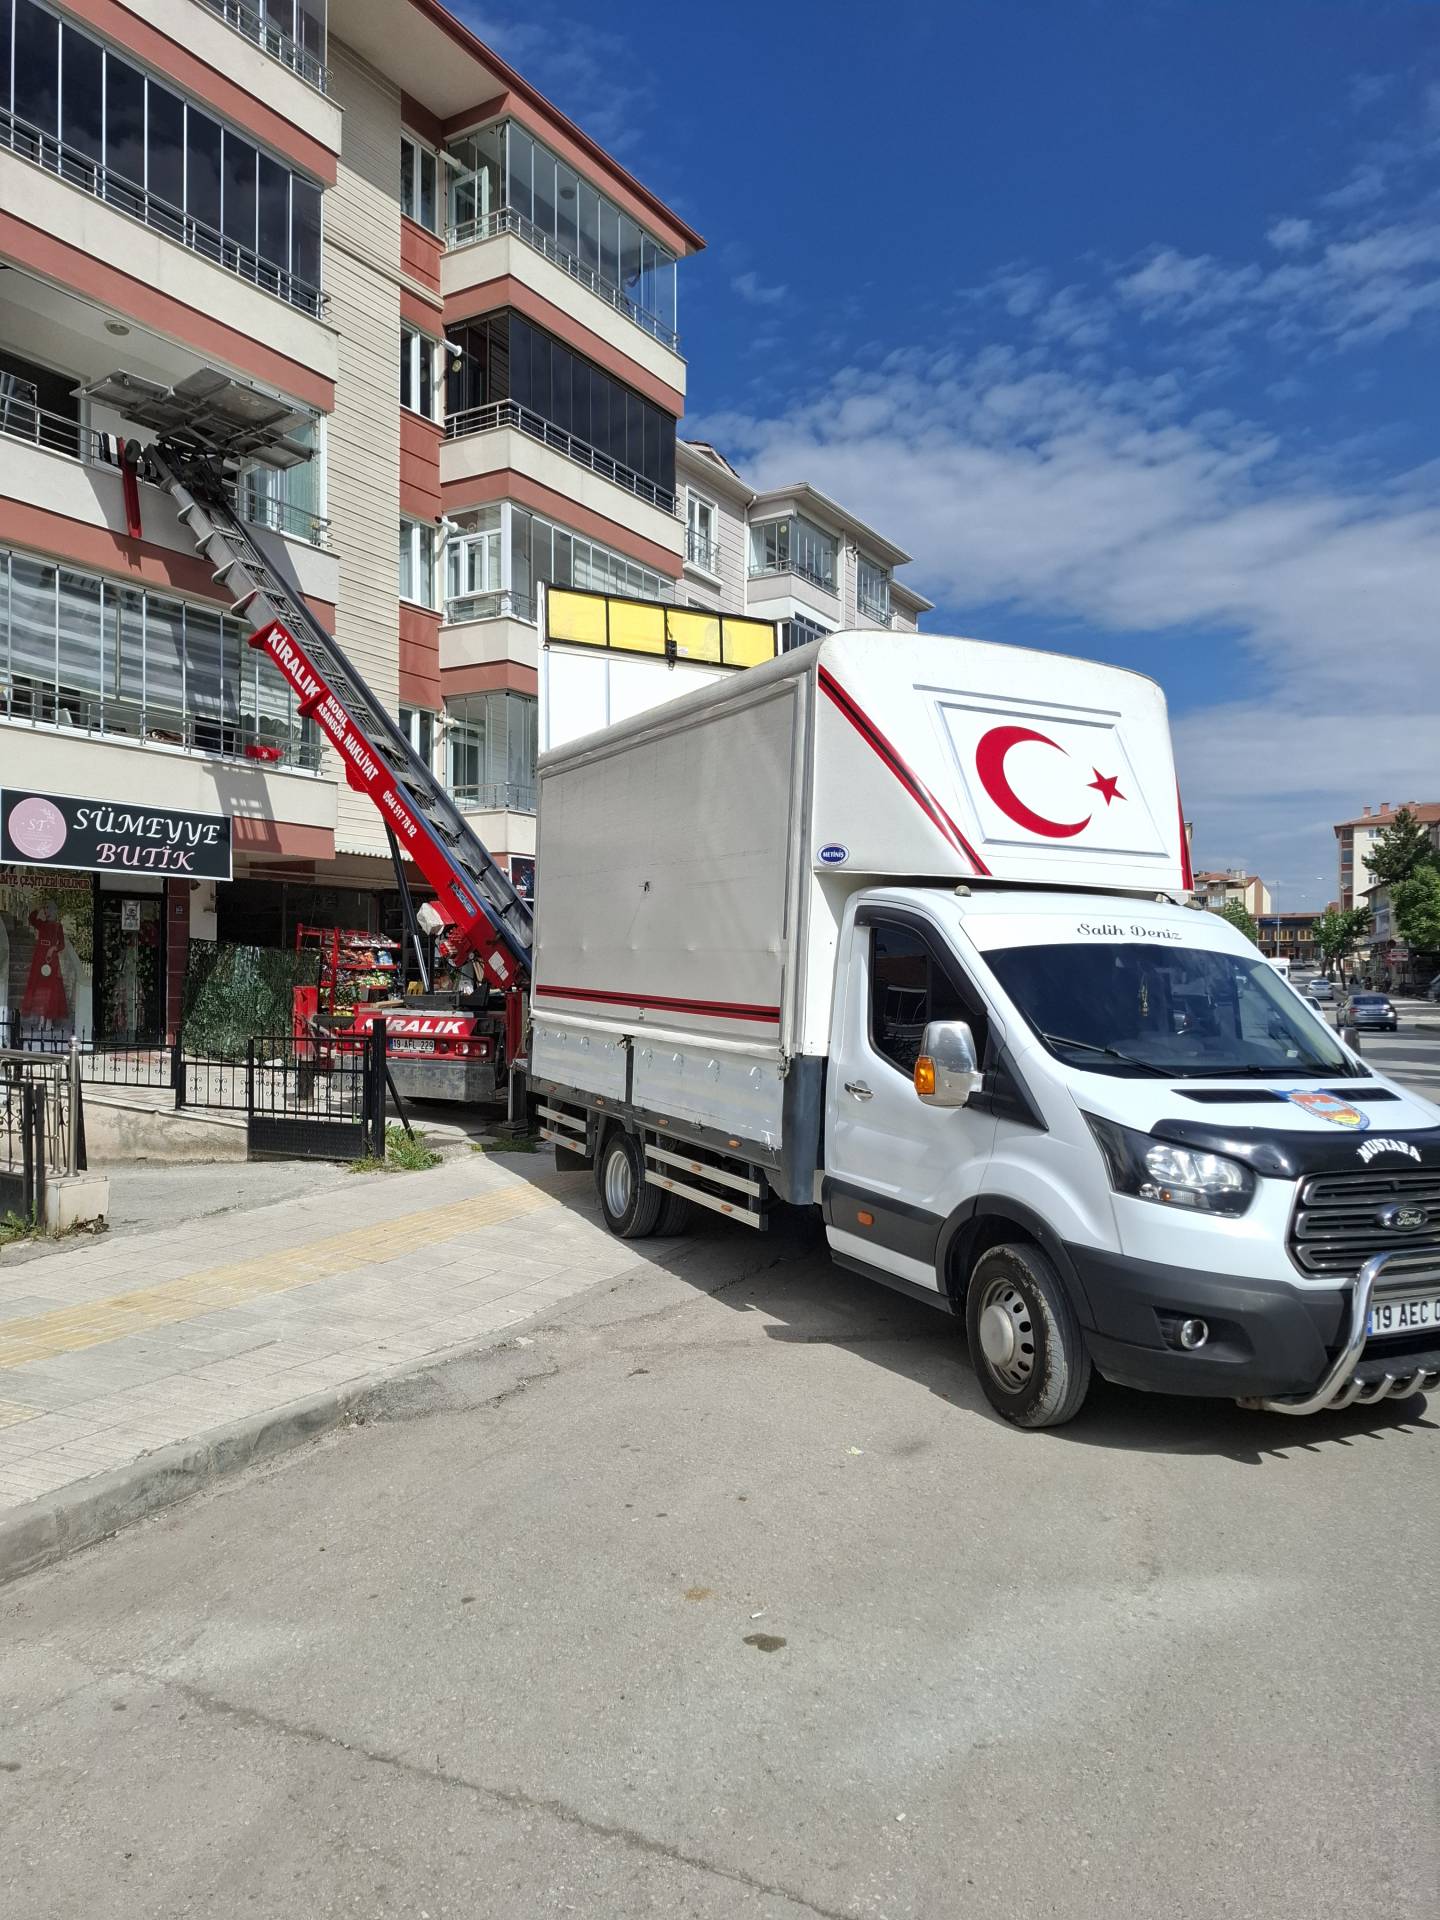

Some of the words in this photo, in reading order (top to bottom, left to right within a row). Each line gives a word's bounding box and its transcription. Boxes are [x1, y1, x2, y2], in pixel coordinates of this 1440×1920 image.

[267, 628, 321, 698] KİRALIK
[326, 695, 349, 729] MOBİL
[316, 703, 345, 741] ASANSÖR
[343, 733, 379, 781] NAKLİYAT
[73, 806, 220, 847] SÜMEYYE
[382, 790, 397, 809] 0544
[393, 805, 405, 820] 517
[401, 815, 411, 829] 78
[407, 824, 417, 838] 92
[96, 843, 196, 871] BUTİK
[1076, 923, 1125, 936] Salih
[1130, 925, 1182, 940] Deniz
[420, 1041, 434, 1050] 229
[1396, 1210, 1421, 1225] Ford
[1375, 1305, 1392, 1330] 19
[1399, 1301, 1429, 1327] AEC
